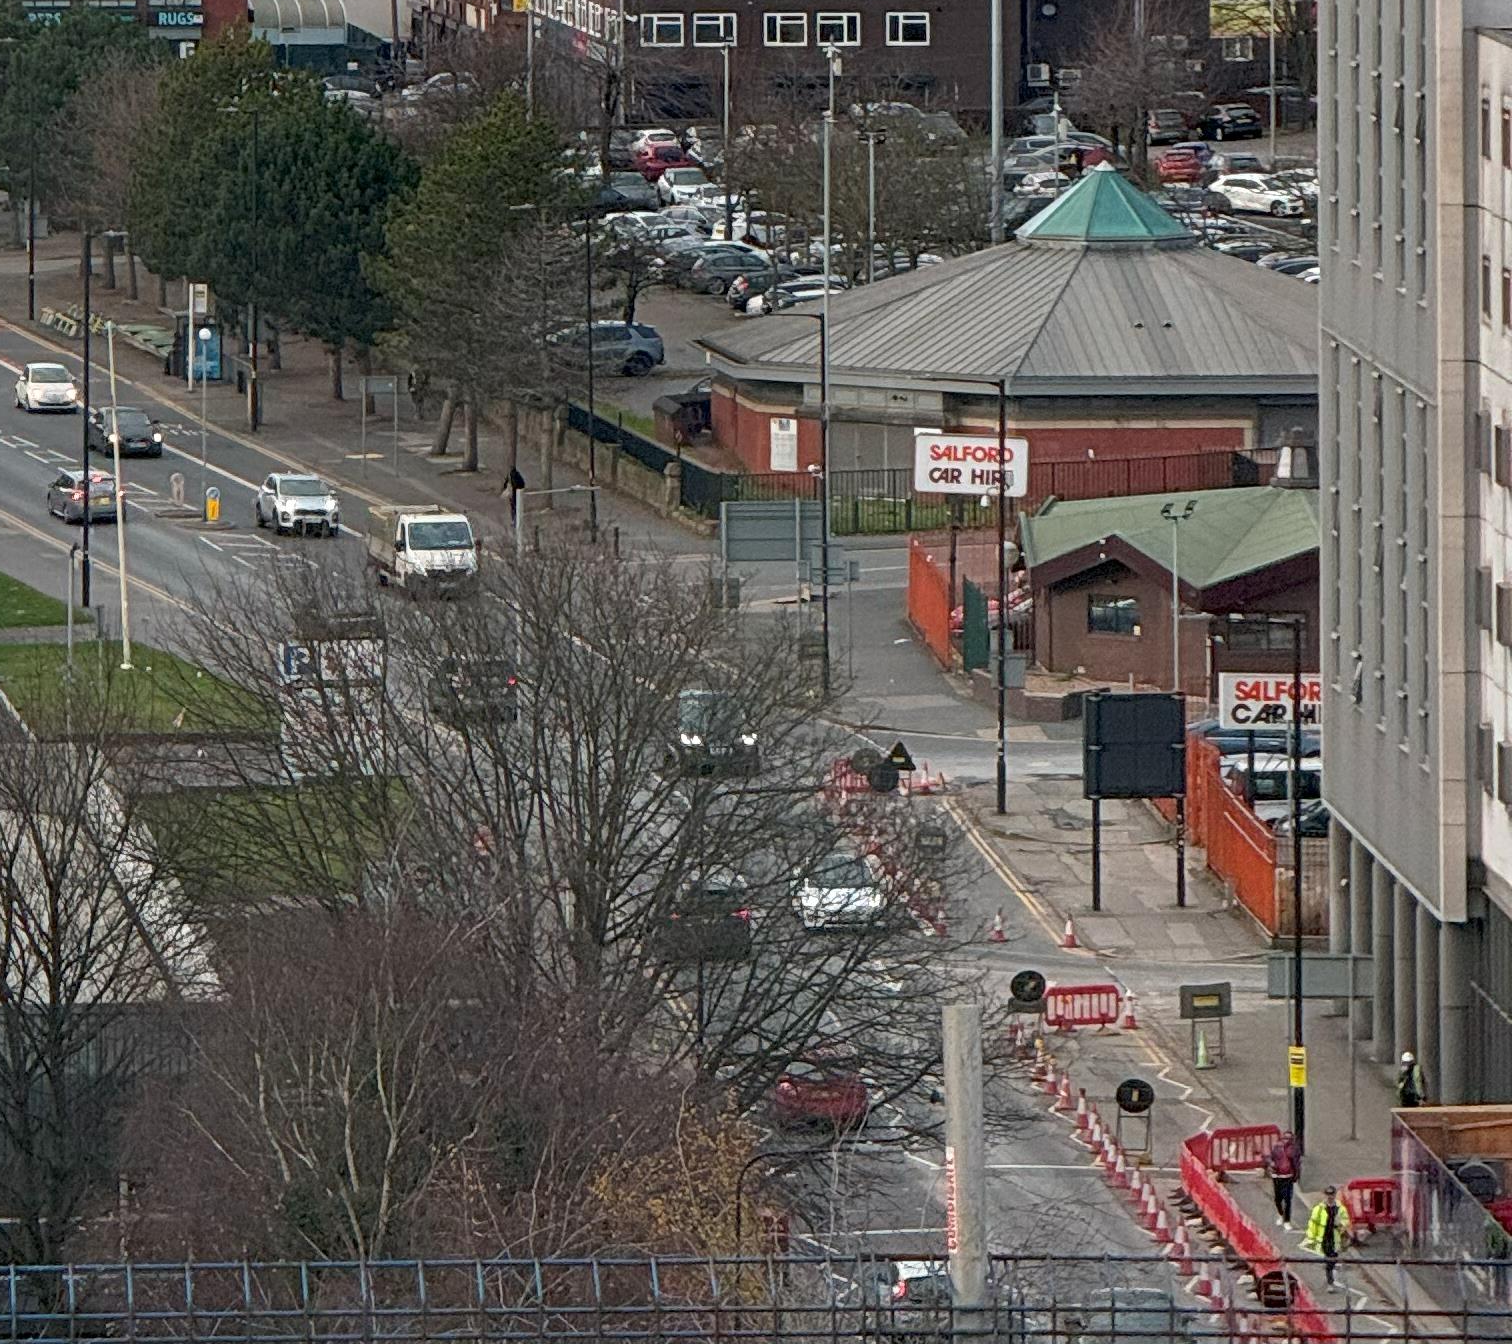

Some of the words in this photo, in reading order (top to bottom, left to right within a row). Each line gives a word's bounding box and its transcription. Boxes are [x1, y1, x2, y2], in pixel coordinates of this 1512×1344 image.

[159, 13, 195, 25] RUGS
[930, 444, 1014, 464] SALFORD
[929, 467, 962, 484] CAR
[1235, 681, 1321, 702] SALFOR
[1231, 703, 1287, 724] CAR
